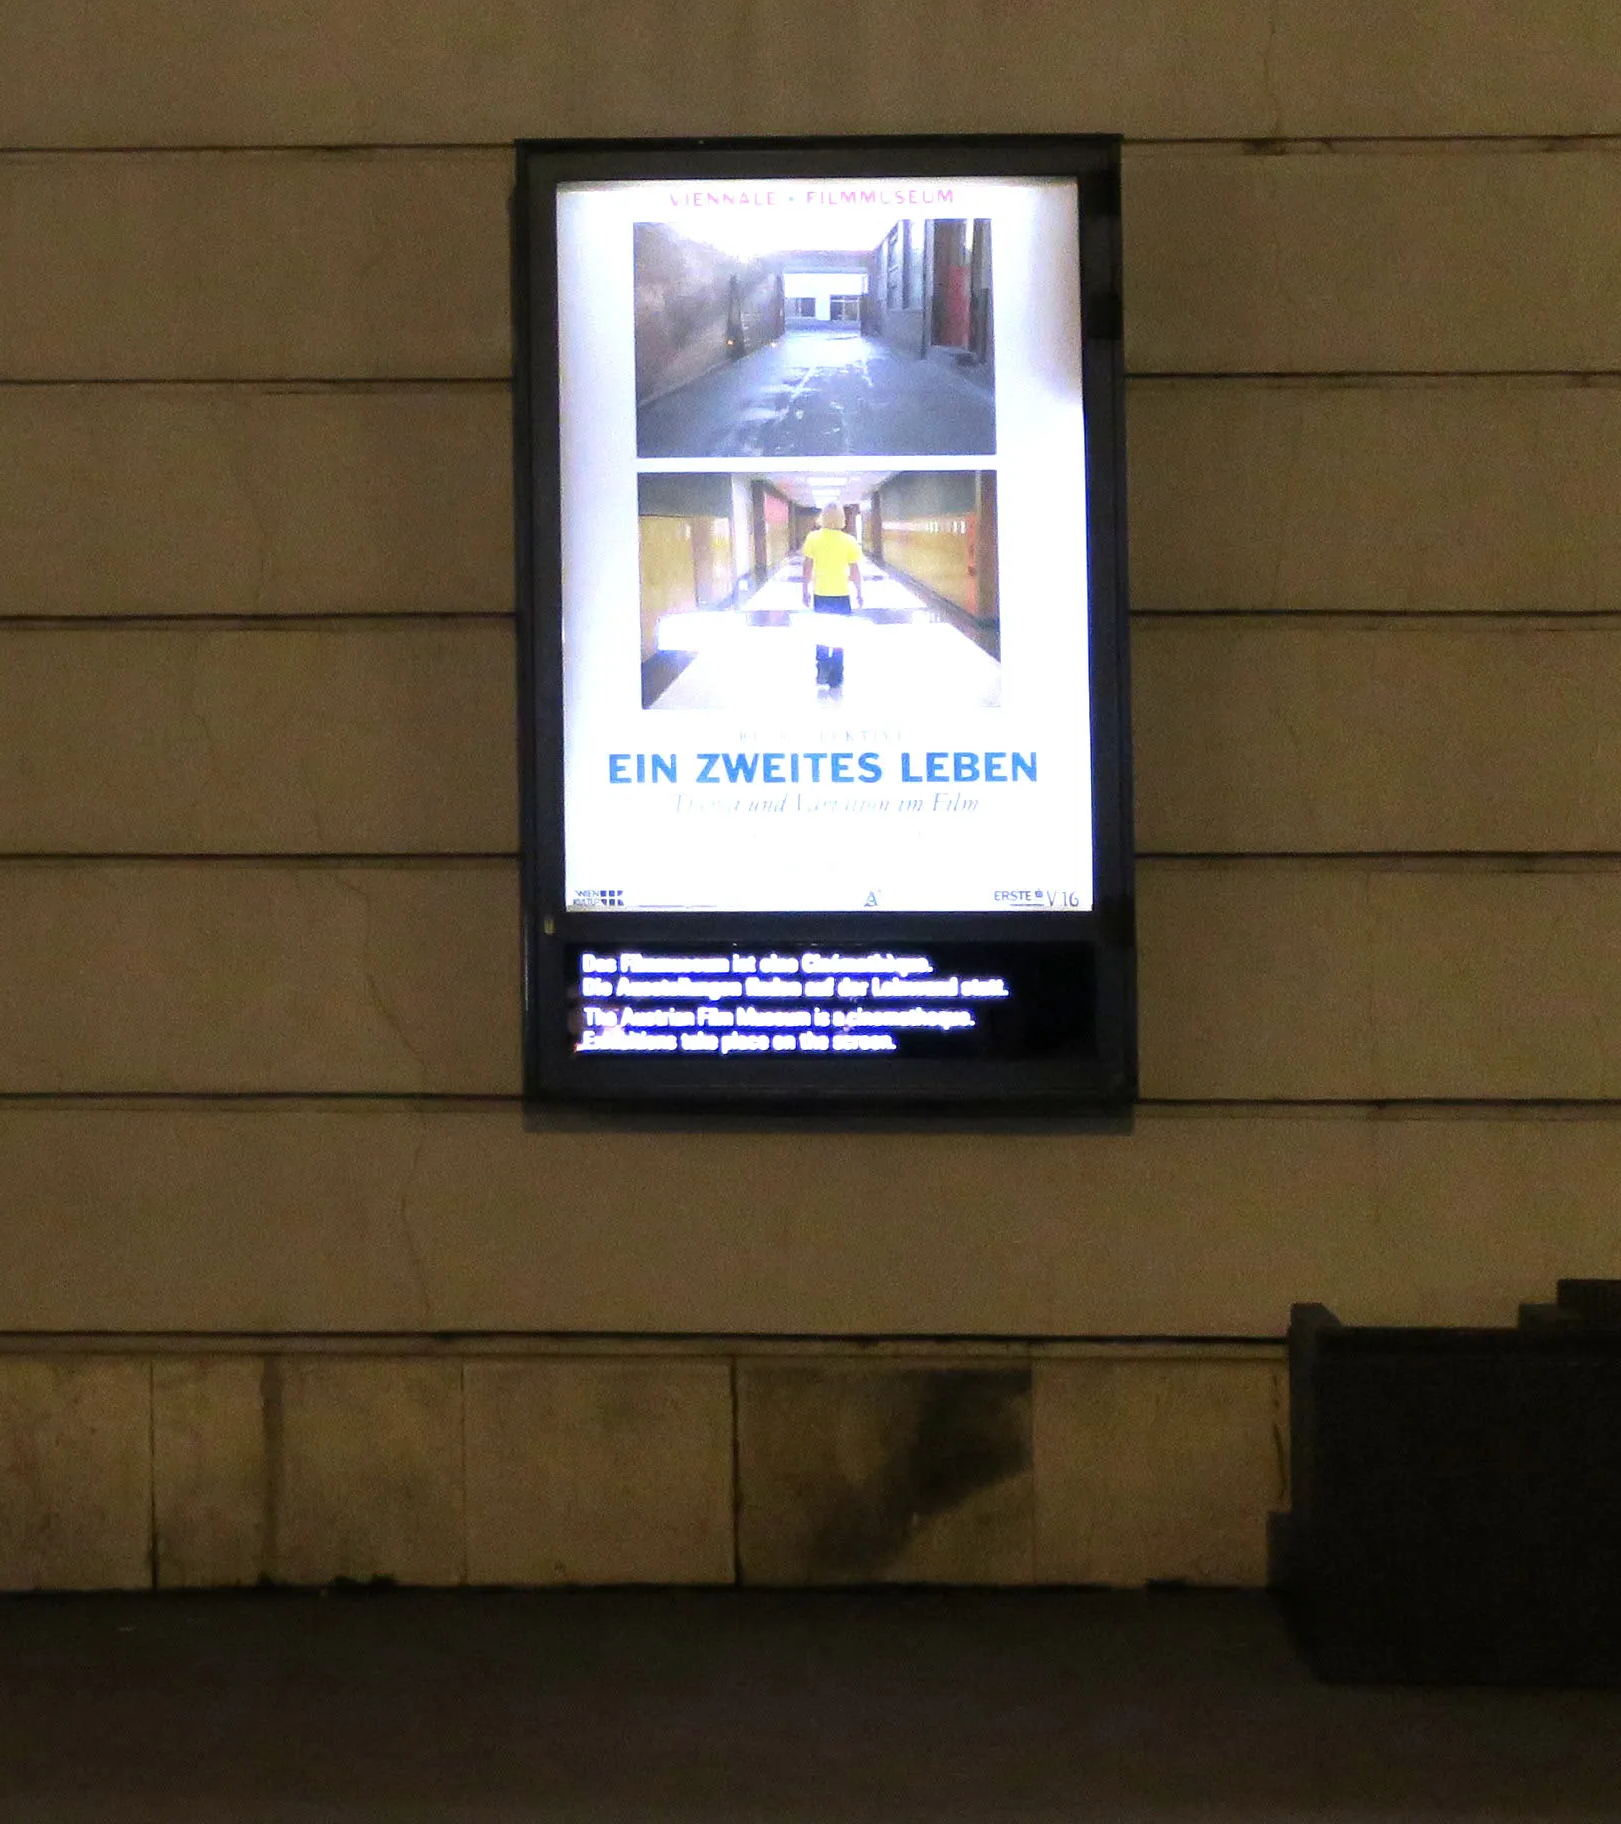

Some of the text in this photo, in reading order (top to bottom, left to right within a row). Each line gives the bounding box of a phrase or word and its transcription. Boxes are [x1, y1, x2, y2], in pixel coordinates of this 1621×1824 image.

[669, 190, 777, 207] VIENNALE
[608, 750, 1039, 785] EIN ZWEITES LEBEN
[748, 793, 788, 814] und
[898, 794, 925, 813] im
[931, 791, 981, 813] Film
[993, 890, 1033, 902] ERSTE
